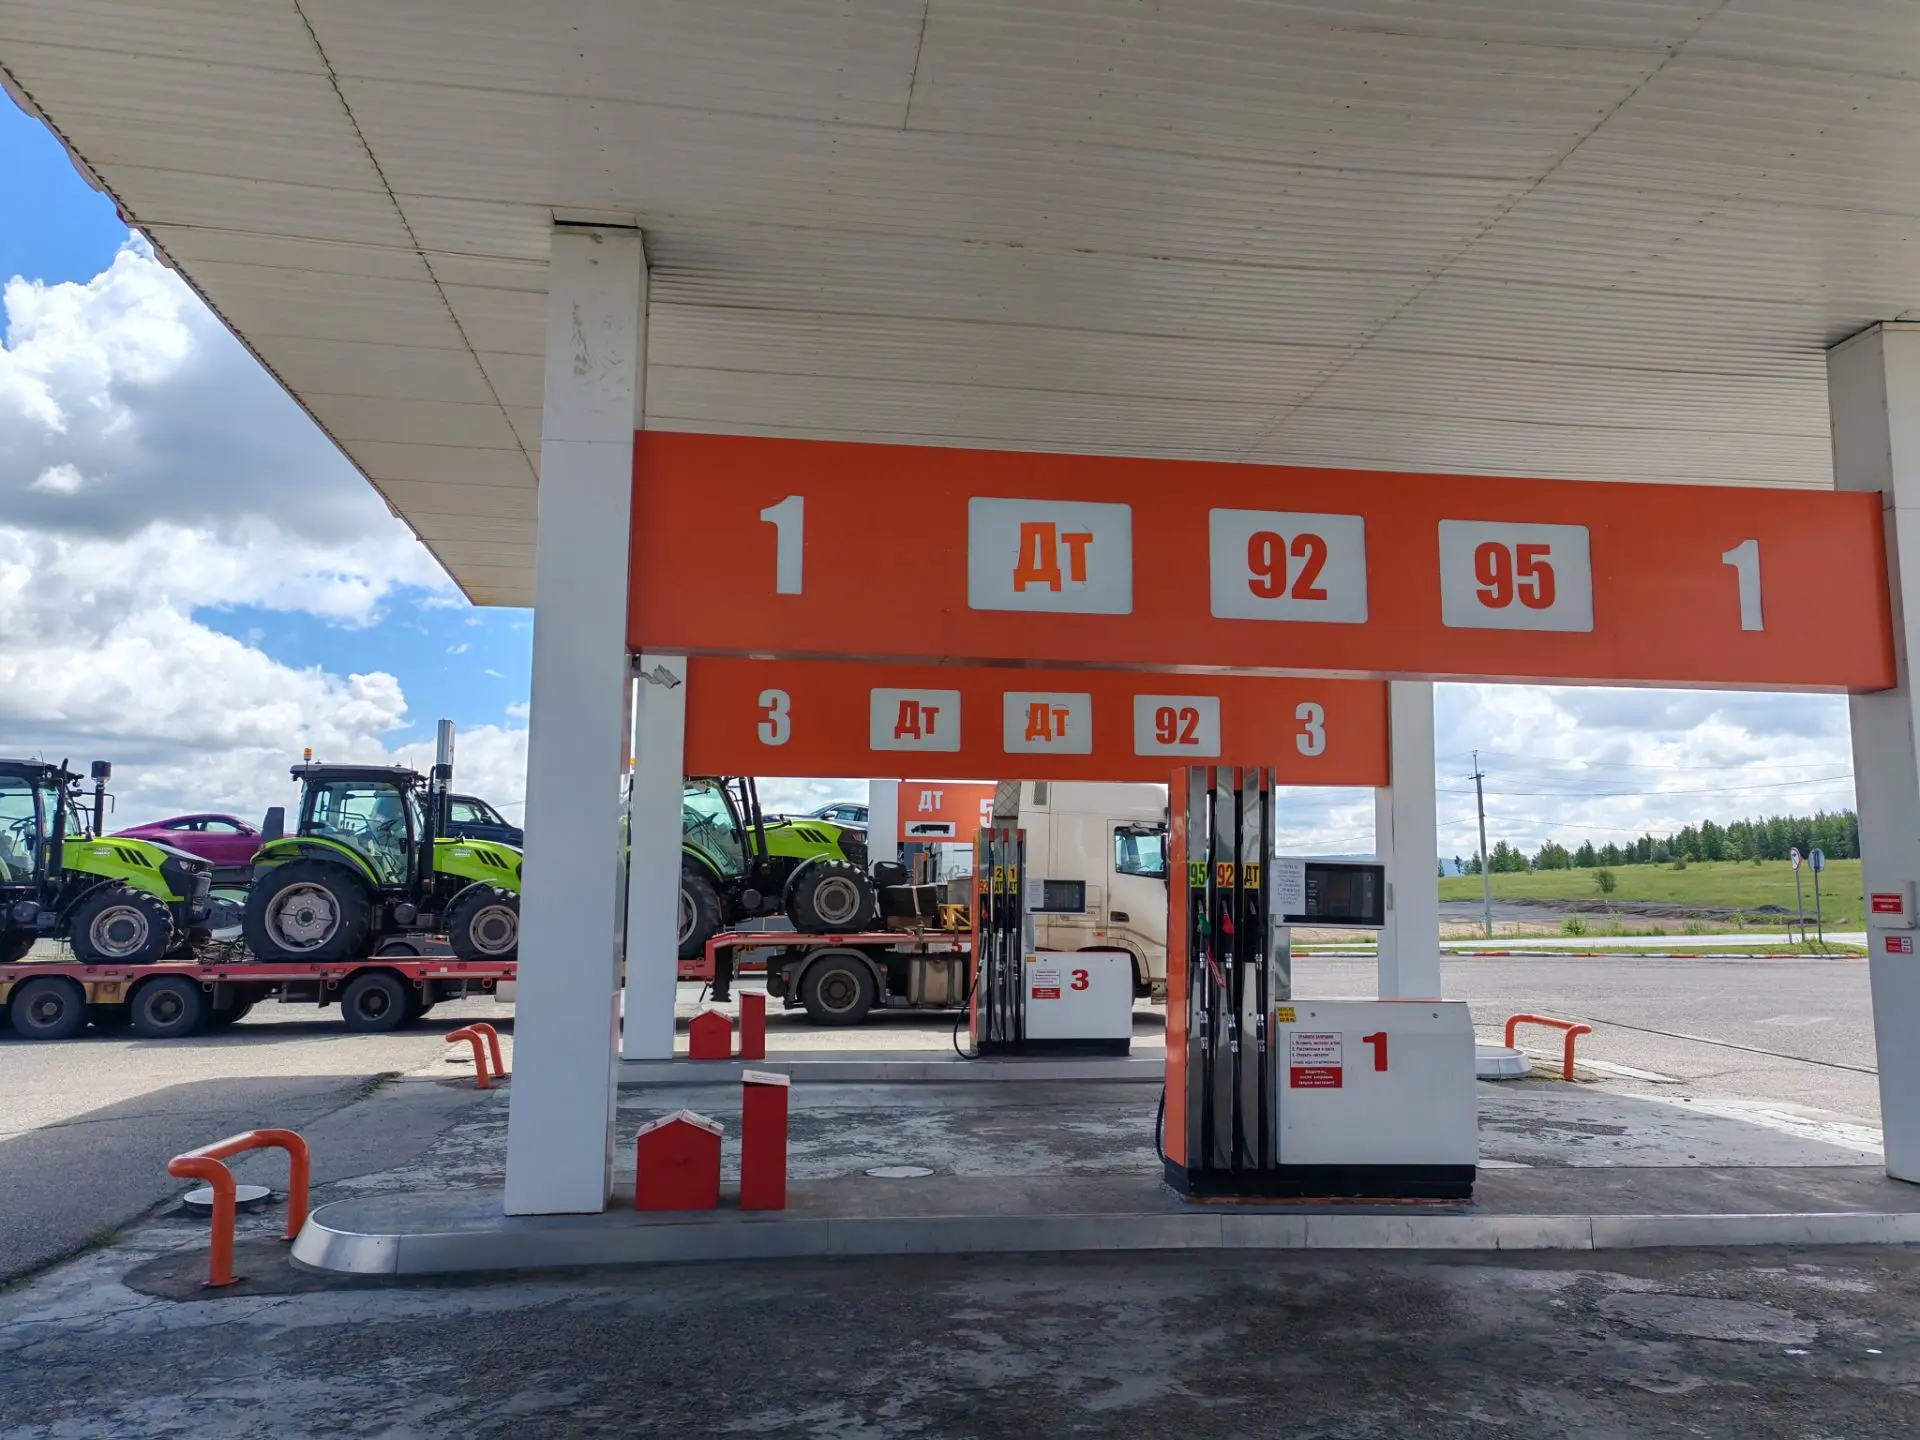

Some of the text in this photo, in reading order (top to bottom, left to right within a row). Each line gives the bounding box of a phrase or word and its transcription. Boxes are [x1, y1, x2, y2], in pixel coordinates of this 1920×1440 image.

[760, 495, 804, 595] 1
[1247, 530, 1328, 601] 92
[1474, 541, 1556, 610] 95
[1722, 539, 1764, 632] 1
[757, 688, 791, 746] 3
[1155, 706, 1200, 745] 92
[1295, 702, 1326, 756] 3
[980, 798, 995, 828] 5
[1190, 863, 1206, 885] 95
[1217, 863, 1234, 886] 92
[1244, 865, 1259, 886] ДТ
[1070, 969, 1089, 991] 3
[1362, 1032, 1388, 1072] 1
